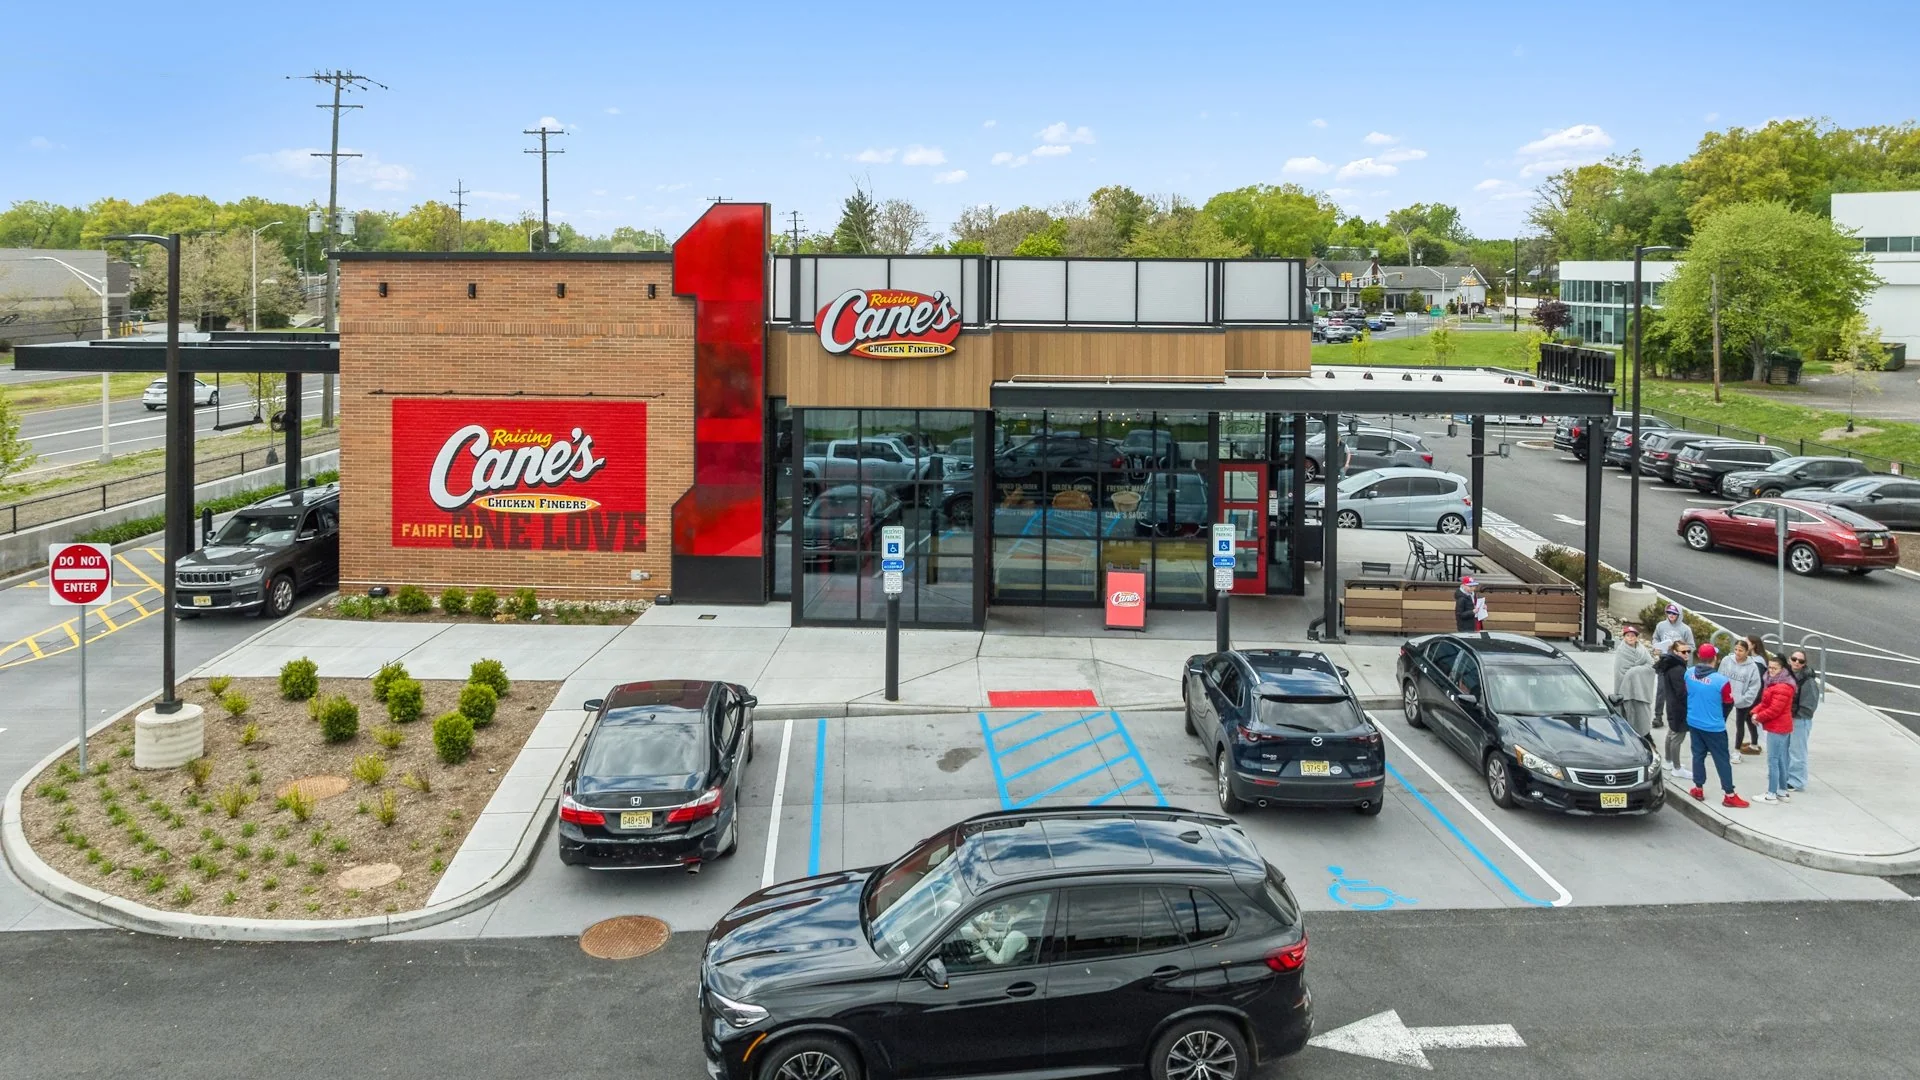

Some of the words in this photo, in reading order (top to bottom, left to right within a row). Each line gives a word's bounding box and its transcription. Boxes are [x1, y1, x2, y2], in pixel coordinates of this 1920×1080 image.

[869, 293, 918, 307] Raising
[820, 288, 961, 353] Cane's
[868, 344, 906, 353] CHICKEN
[908, 345, 946, 353] FINGERS
[491, 429, 553, 447] Raising
[428, 424, 606, 510] Cane's
[486, 497, 536, 509] CHICKEN
[538, 497, 588, 510] FINGERS
[401, 523, 483, 539] FAIRFIELD
[452, 511, 533, 551] ONE
[542, 512, 647, 552] LOVE
[59, 556, 74, 566] DO
[80, 556, 101, 566] NOT
[63, 582, 97, 593] ENTER
